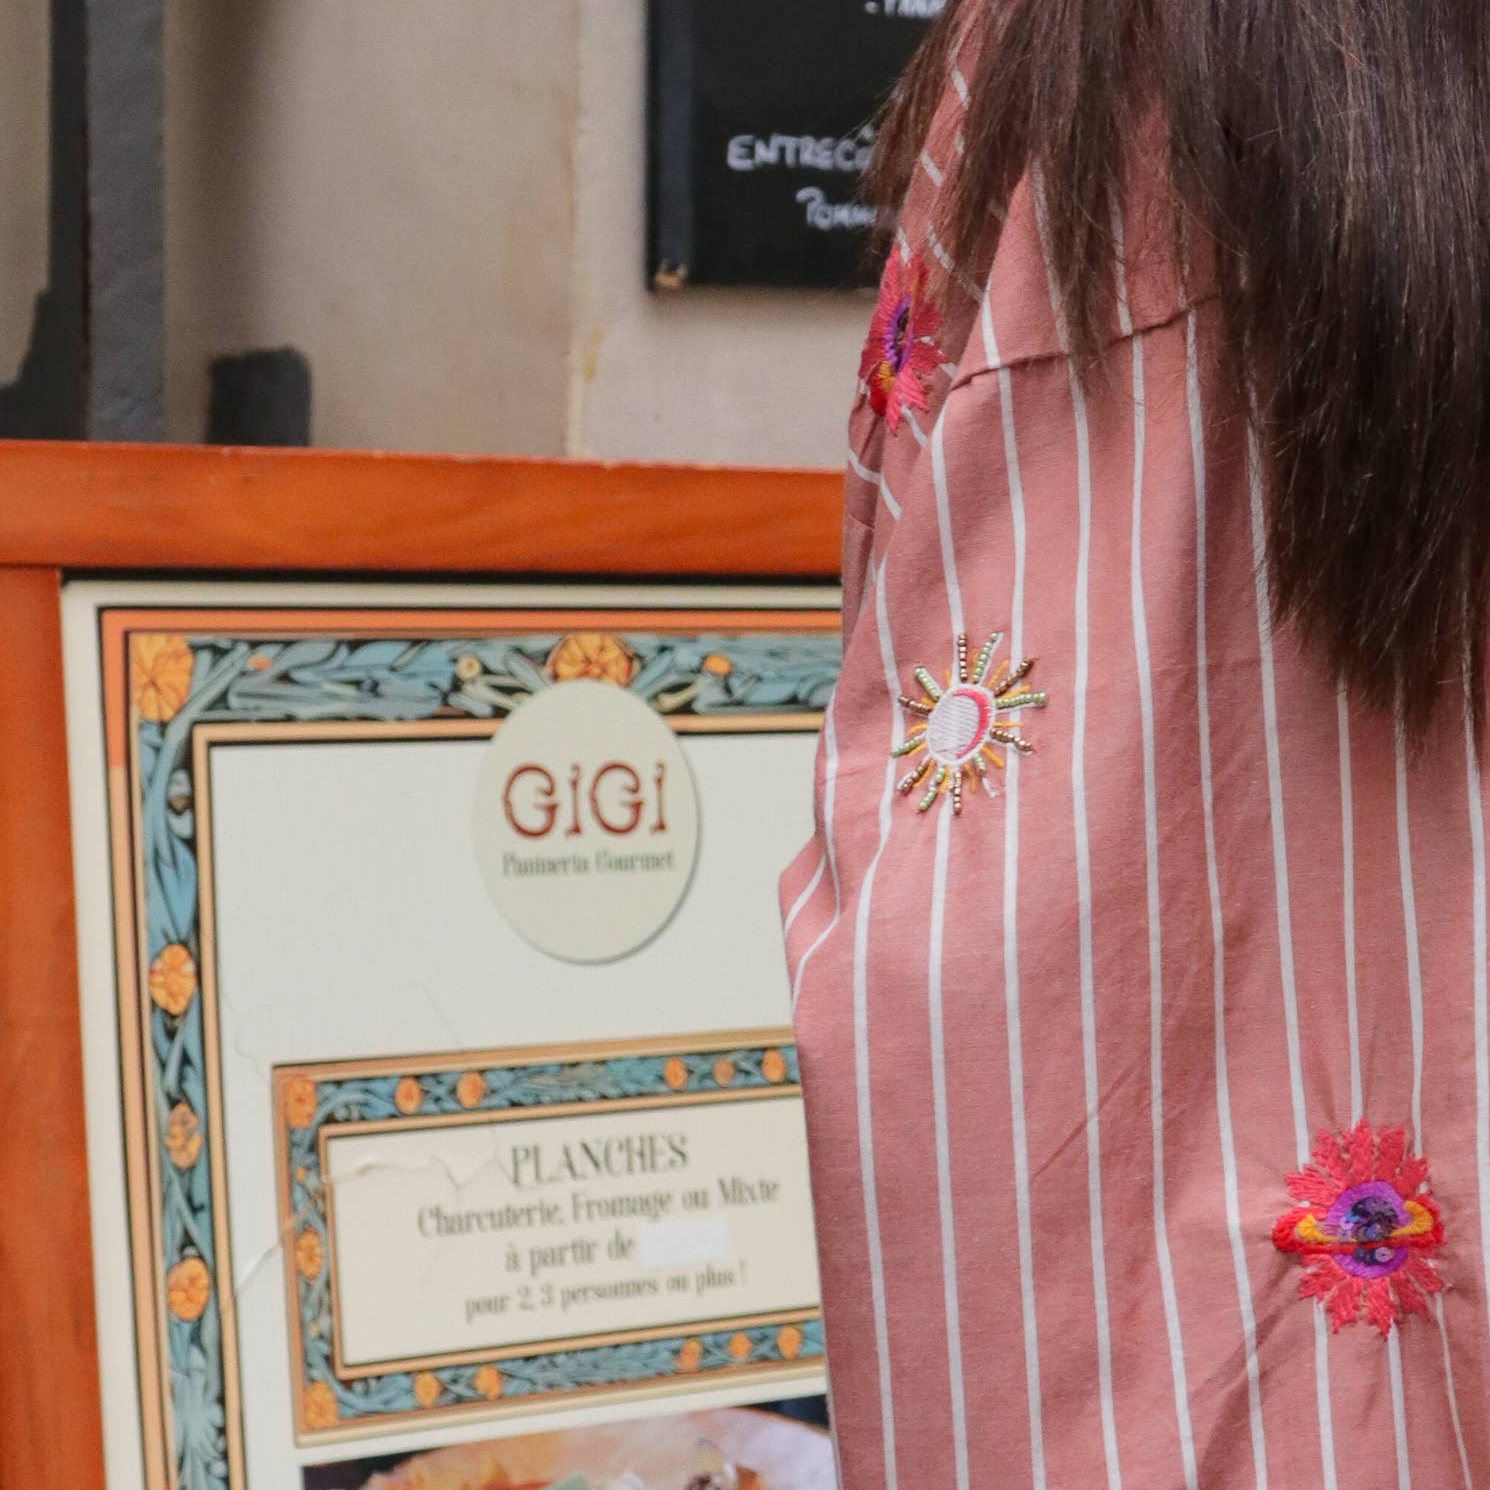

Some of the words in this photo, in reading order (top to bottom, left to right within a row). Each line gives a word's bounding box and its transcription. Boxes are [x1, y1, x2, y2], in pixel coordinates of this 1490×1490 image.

[503, 851, 588, 876] Panineria
[596, 850, 673, 871] Gourmet
[511, 1133, 688, 1187] PLANCHES
[571, 1190, 672, 1224] Fromage
[682, 1188, 710, 1208] ou
[718, 1175, 779, 1205] Mixte
[505, 1244, 520, 1272] à
[529, 1236, 598, 1278] partir
[607, 1230, 634, 1260] de
[465, 1294, 510, 1324] pour
[540, 1284, 553, 1304] 3
[560, 1275, 658, 1312] personnes
[666, 1272, 687, 1292] ou
